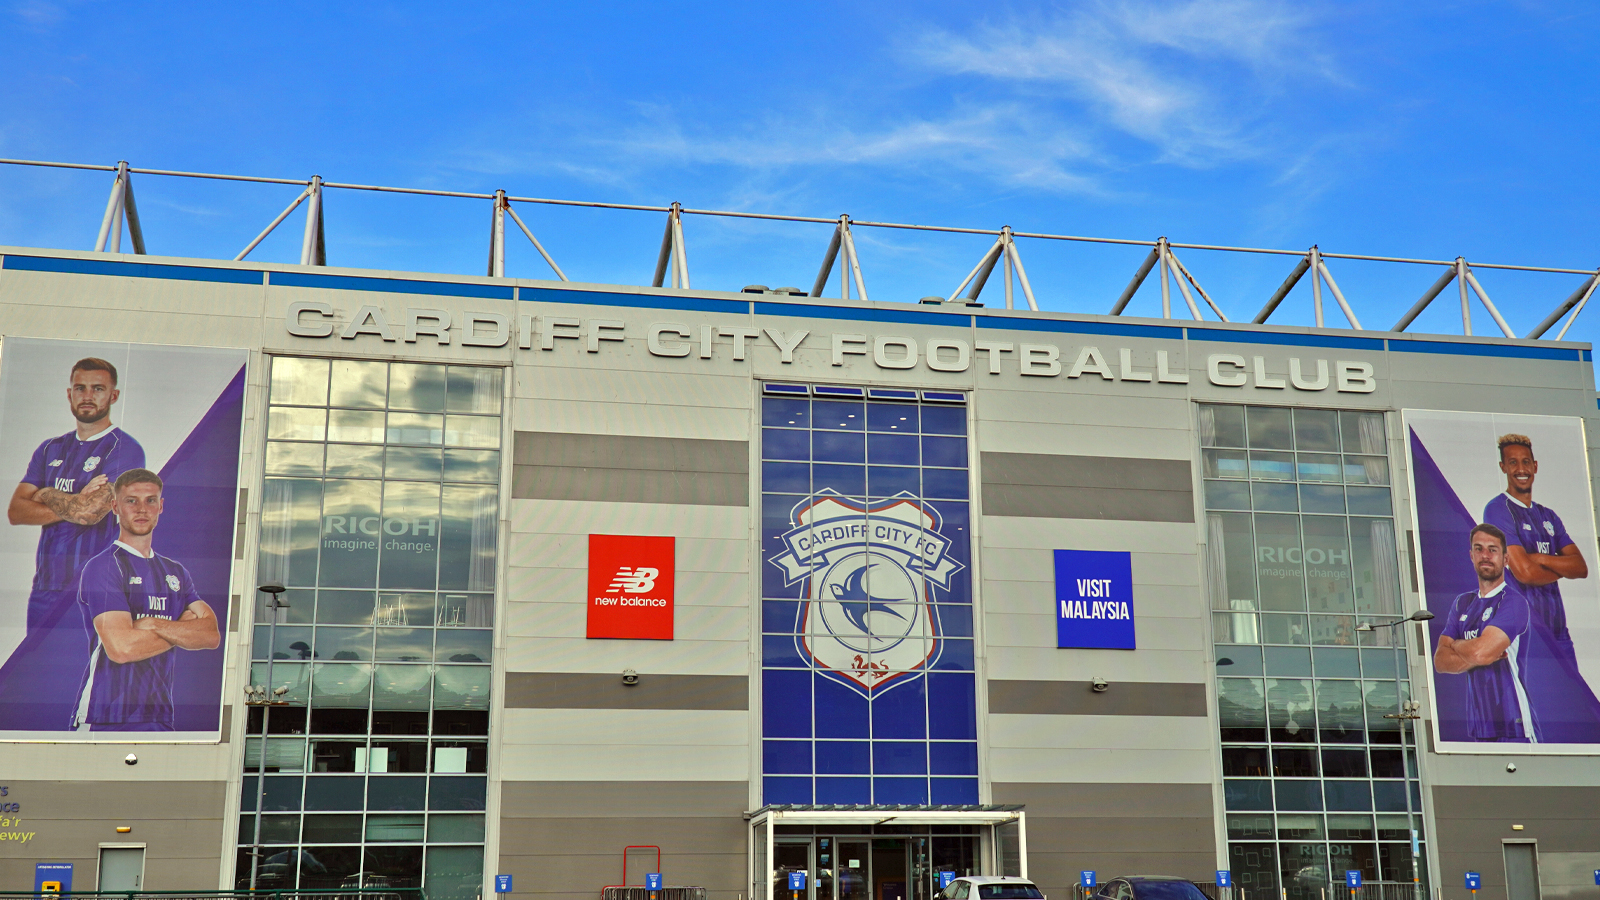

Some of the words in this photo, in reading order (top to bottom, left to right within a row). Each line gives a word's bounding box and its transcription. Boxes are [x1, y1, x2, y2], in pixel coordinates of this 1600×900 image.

[286, 301, 625, 353] CARDIFF
[648, 323, 810, 363] CITY
[832, 333, 1189, 384] FOOTBALL
[1207, 353, 1377, 393] CLUB
[55, 477, 75, 492] VISIT
[325, 516, 436, 536] RICOH
[324, 537, 378, 552] imagine.
[385, 539, 434, 554] change.
[798, 525, 869, 551] CARDIFF
[875, 525, 913, 544] CITY
[915, 537, 937, 556] FC
[1258, 546, 1348, 565] RICOH
[1076, 578, 1112, 598] VISIT
[595, 597, 618, 606] new
[620, 596, 667, 607] balance
[1061, 600, 1130, 620] MALAYSIA
[1300, 844, 1352, 856] RICOH
